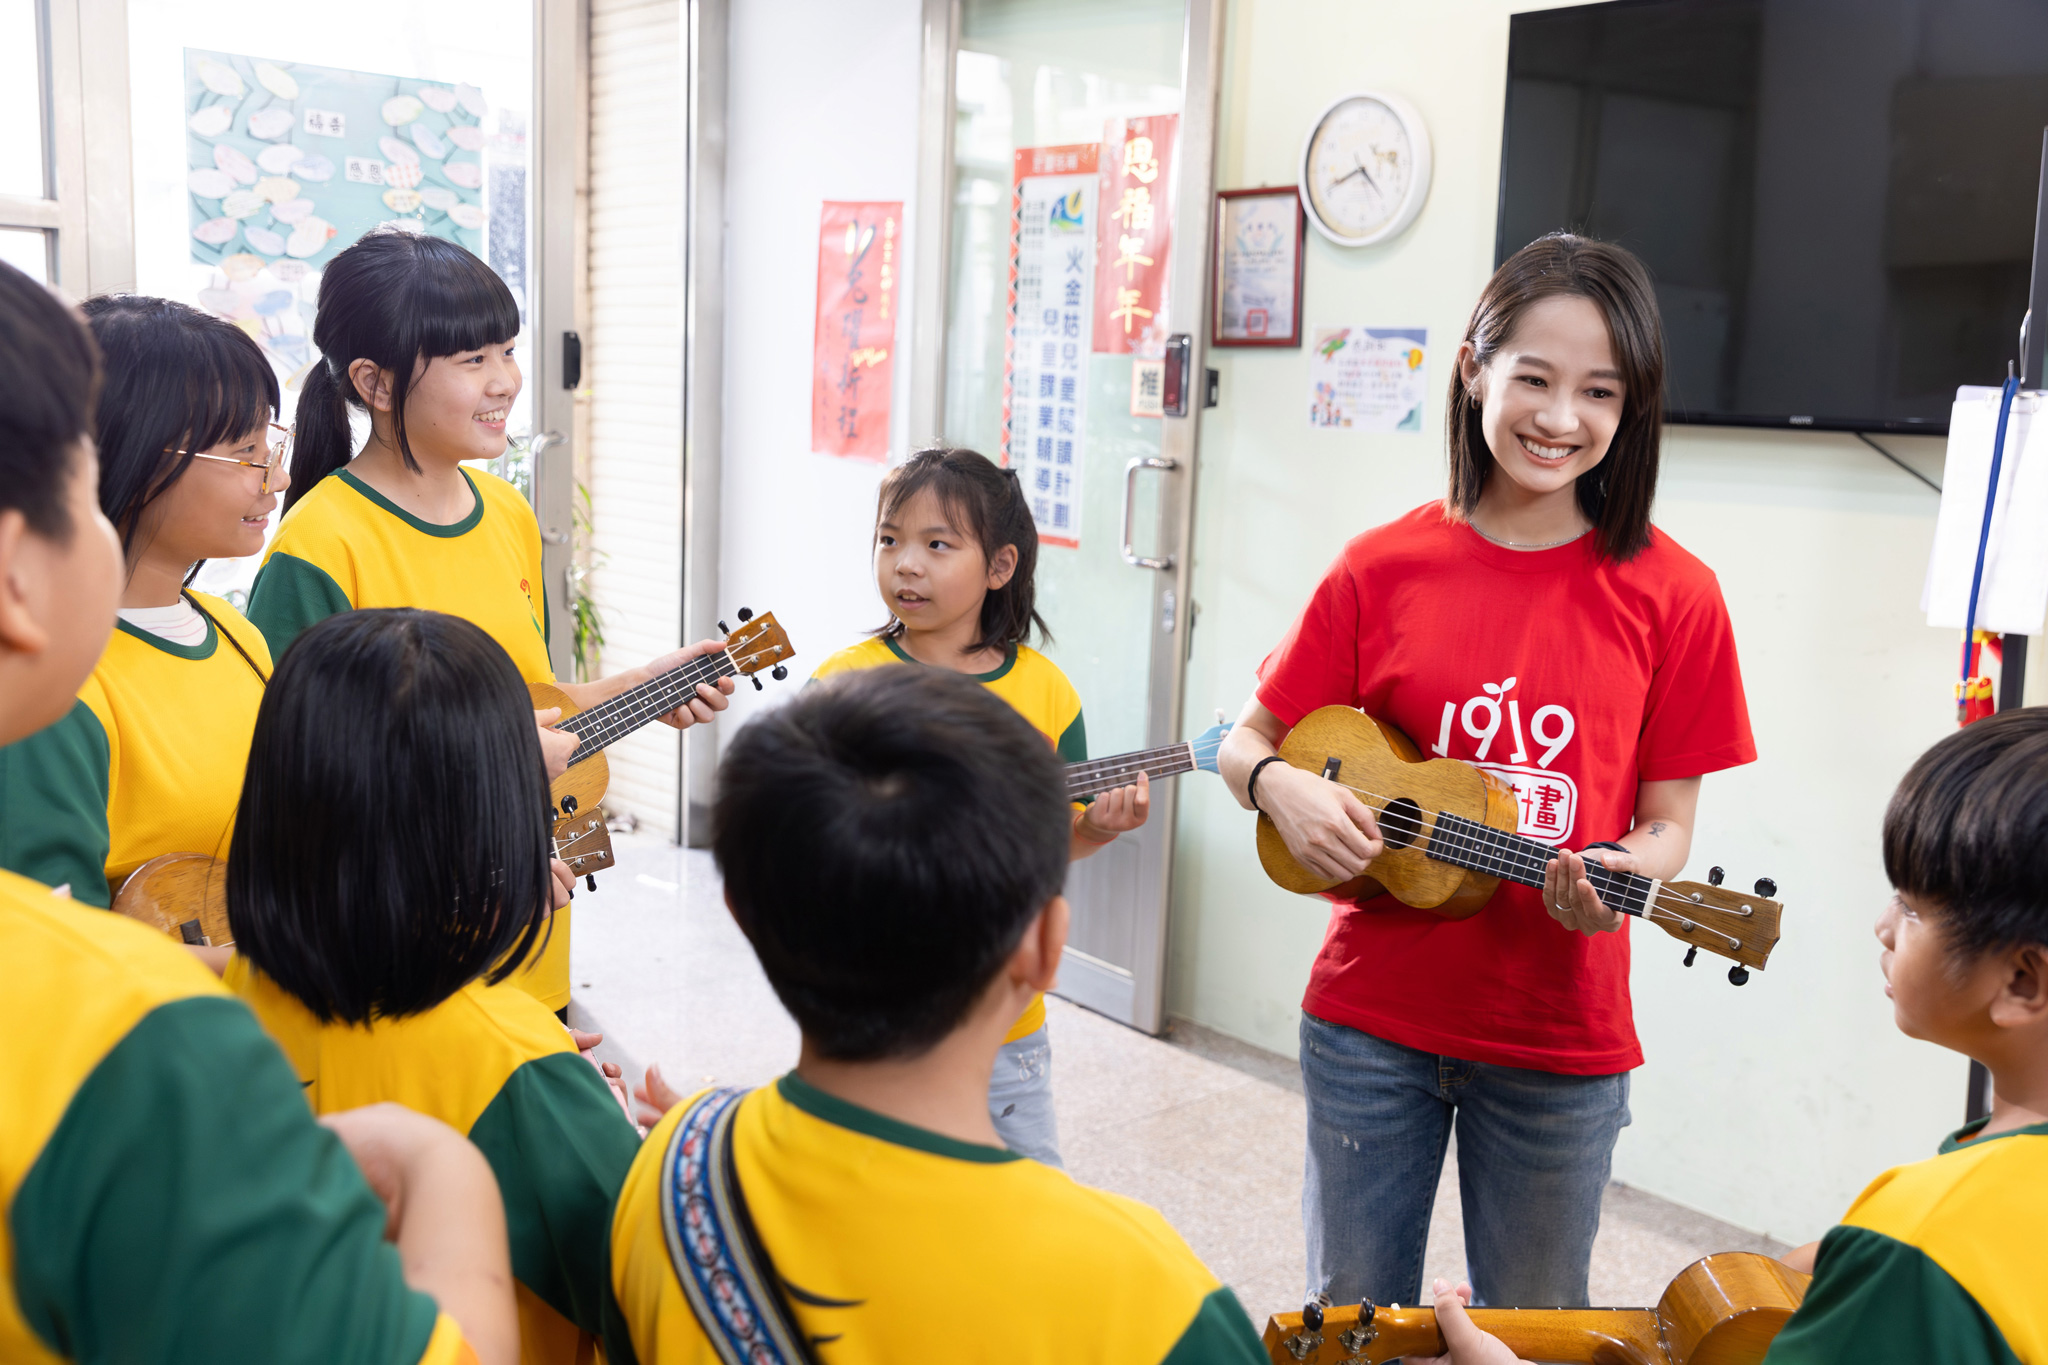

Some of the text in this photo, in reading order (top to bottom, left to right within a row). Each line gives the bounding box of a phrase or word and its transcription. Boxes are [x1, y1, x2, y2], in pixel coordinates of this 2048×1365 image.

[1110, 136, 1158, 335] 恩福年年
[1033, 307, 1059, 527] 兒童課業輔導班
[1140, 368, 1159, 396] 推
[1432, 695, 1575, 769] 1919
